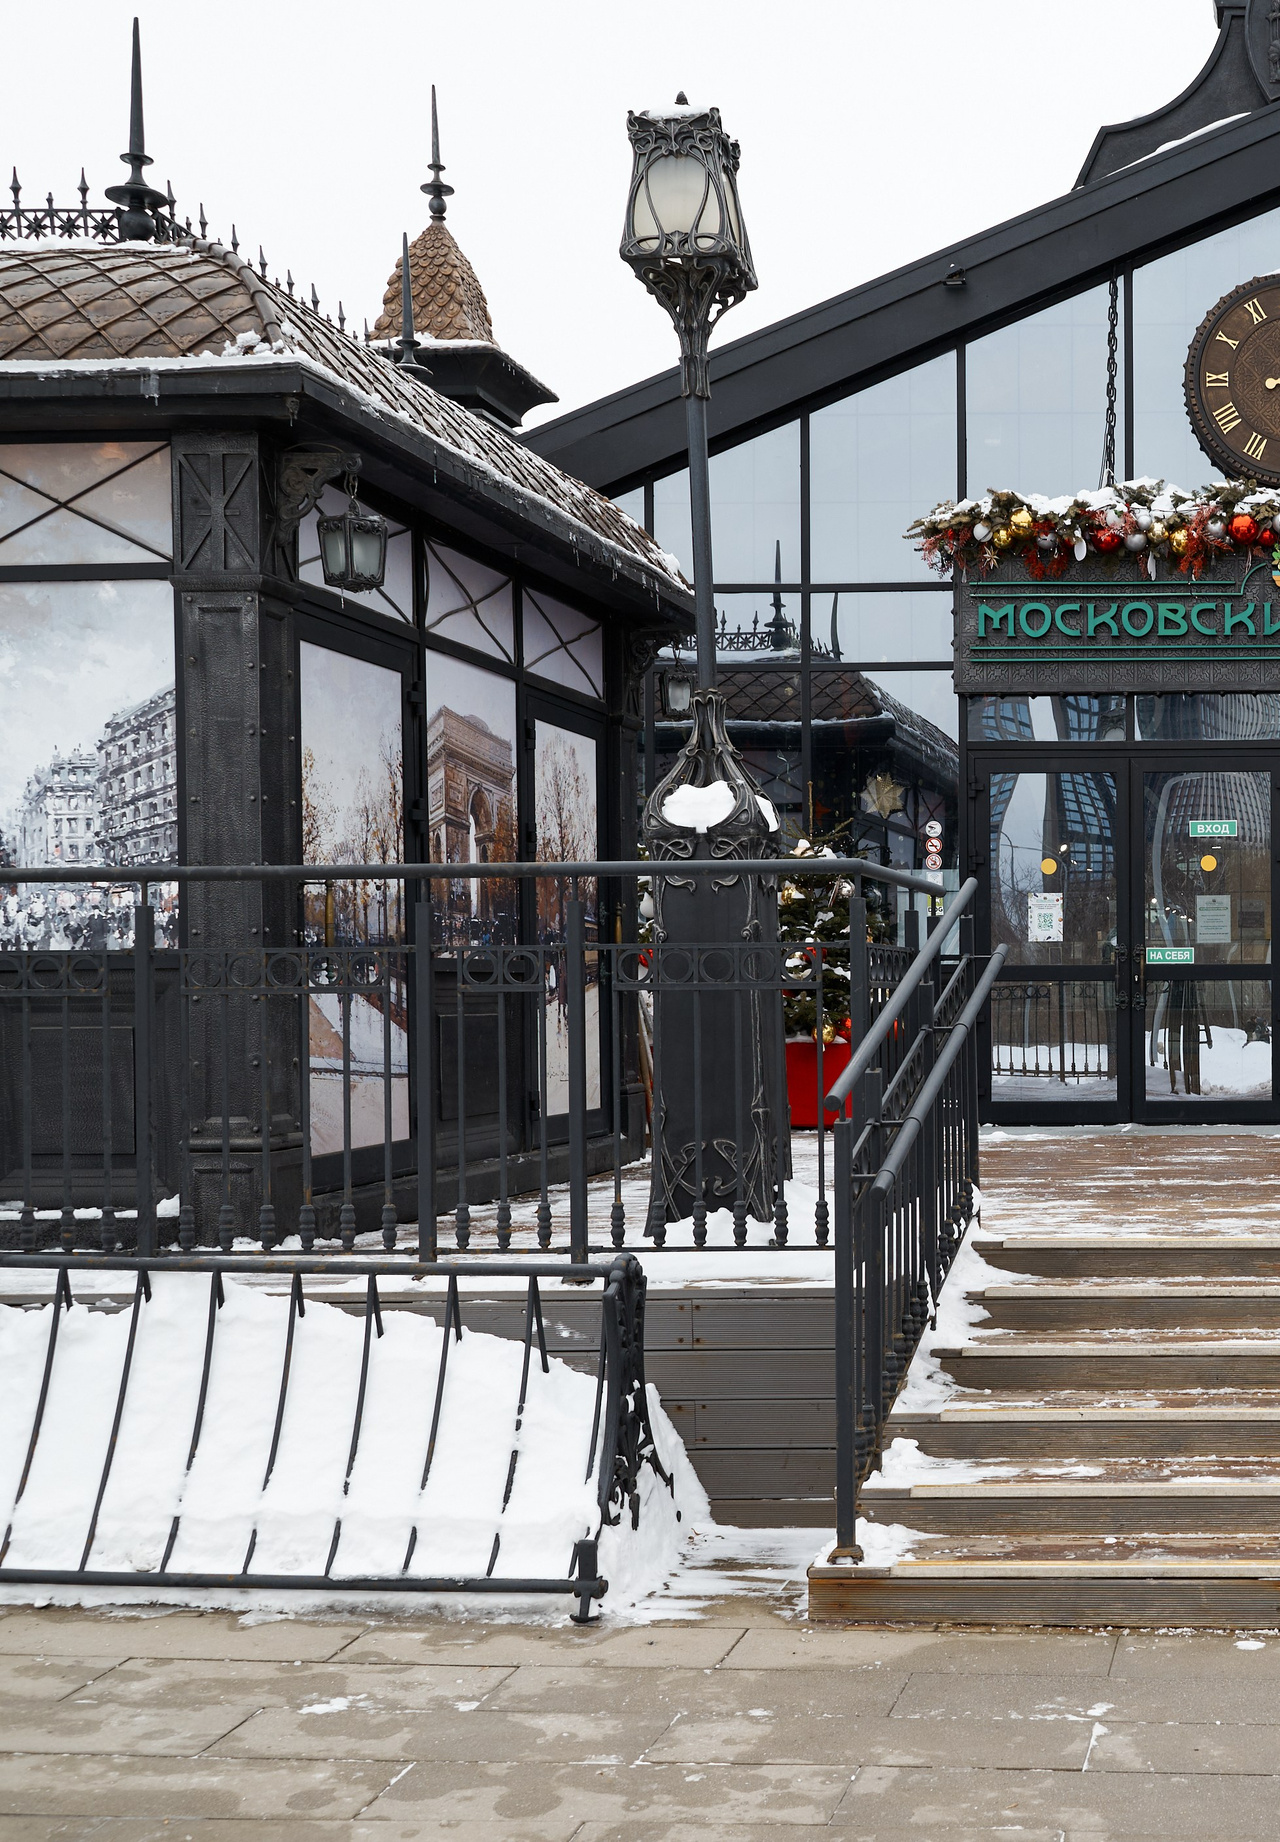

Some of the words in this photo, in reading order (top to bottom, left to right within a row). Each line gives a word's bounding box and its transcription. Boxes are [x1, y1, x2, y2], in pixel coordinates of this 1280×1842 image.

[1243, 297, 1268, 325] XI
[1215, 330, 1240, 350] X
[1205, 371, 1229, 388] IX
[1212, 401, 1242, 435] VIII
[1242, 431, 1268, 461] VII
[1197, 824, 1230, 834] ВХОД
[1150, 951, 1163, 960] НА
[1165, 951, 1190, 960] СЕБЯ
